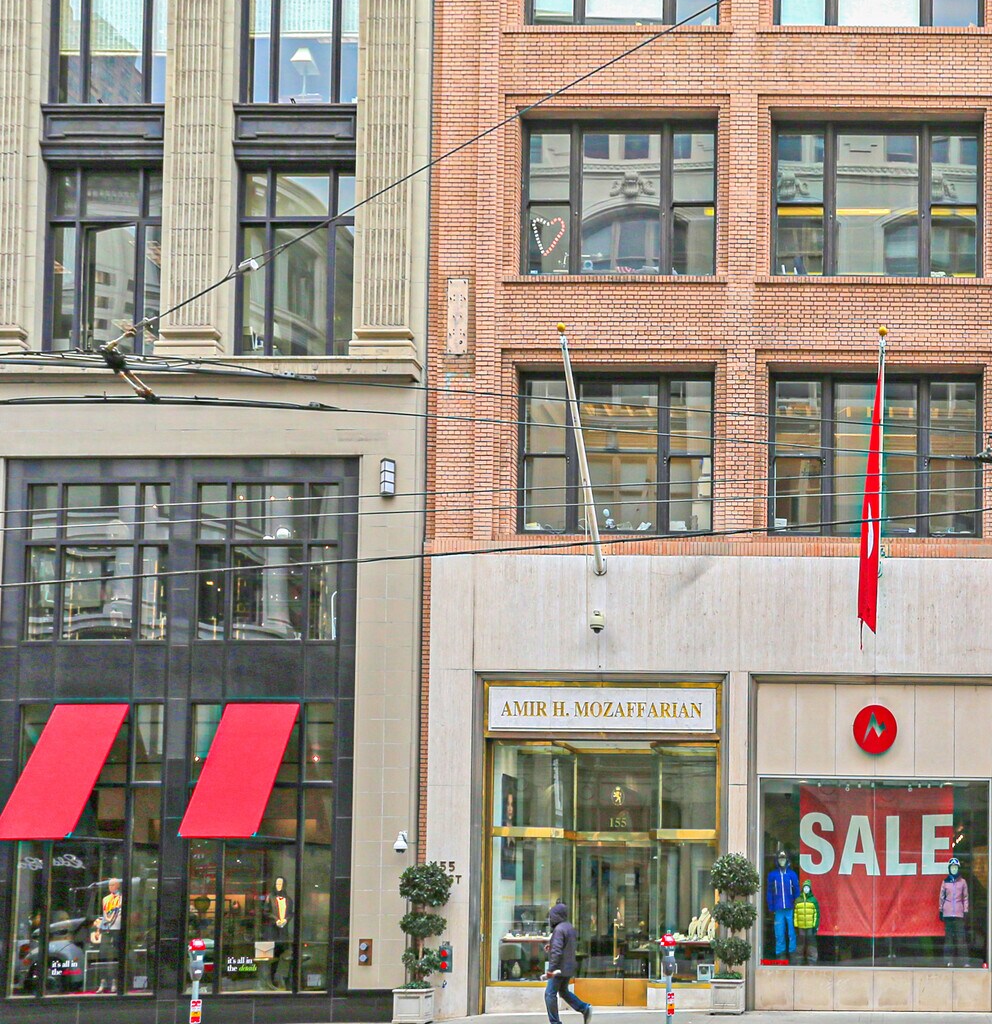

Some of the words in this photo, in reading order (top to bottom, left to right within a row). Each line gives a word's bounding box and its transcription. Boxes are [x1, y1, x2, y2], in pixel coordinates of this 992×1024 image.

[500, 700, 548, 717] AMIR
[552, 701, 570, 717] H.
[574, 701, 703, 718] MOZAFFARIAN
[609, 817, 627, 828] 155
[800, 811, 954, 876] SALE
[51, 960, 62, 968] it's
[62, 960, 70, 968] all
[227, 956, 237, 964] it's
[237, 956, 245, 964] all
[227, 964, 238, 972] the
